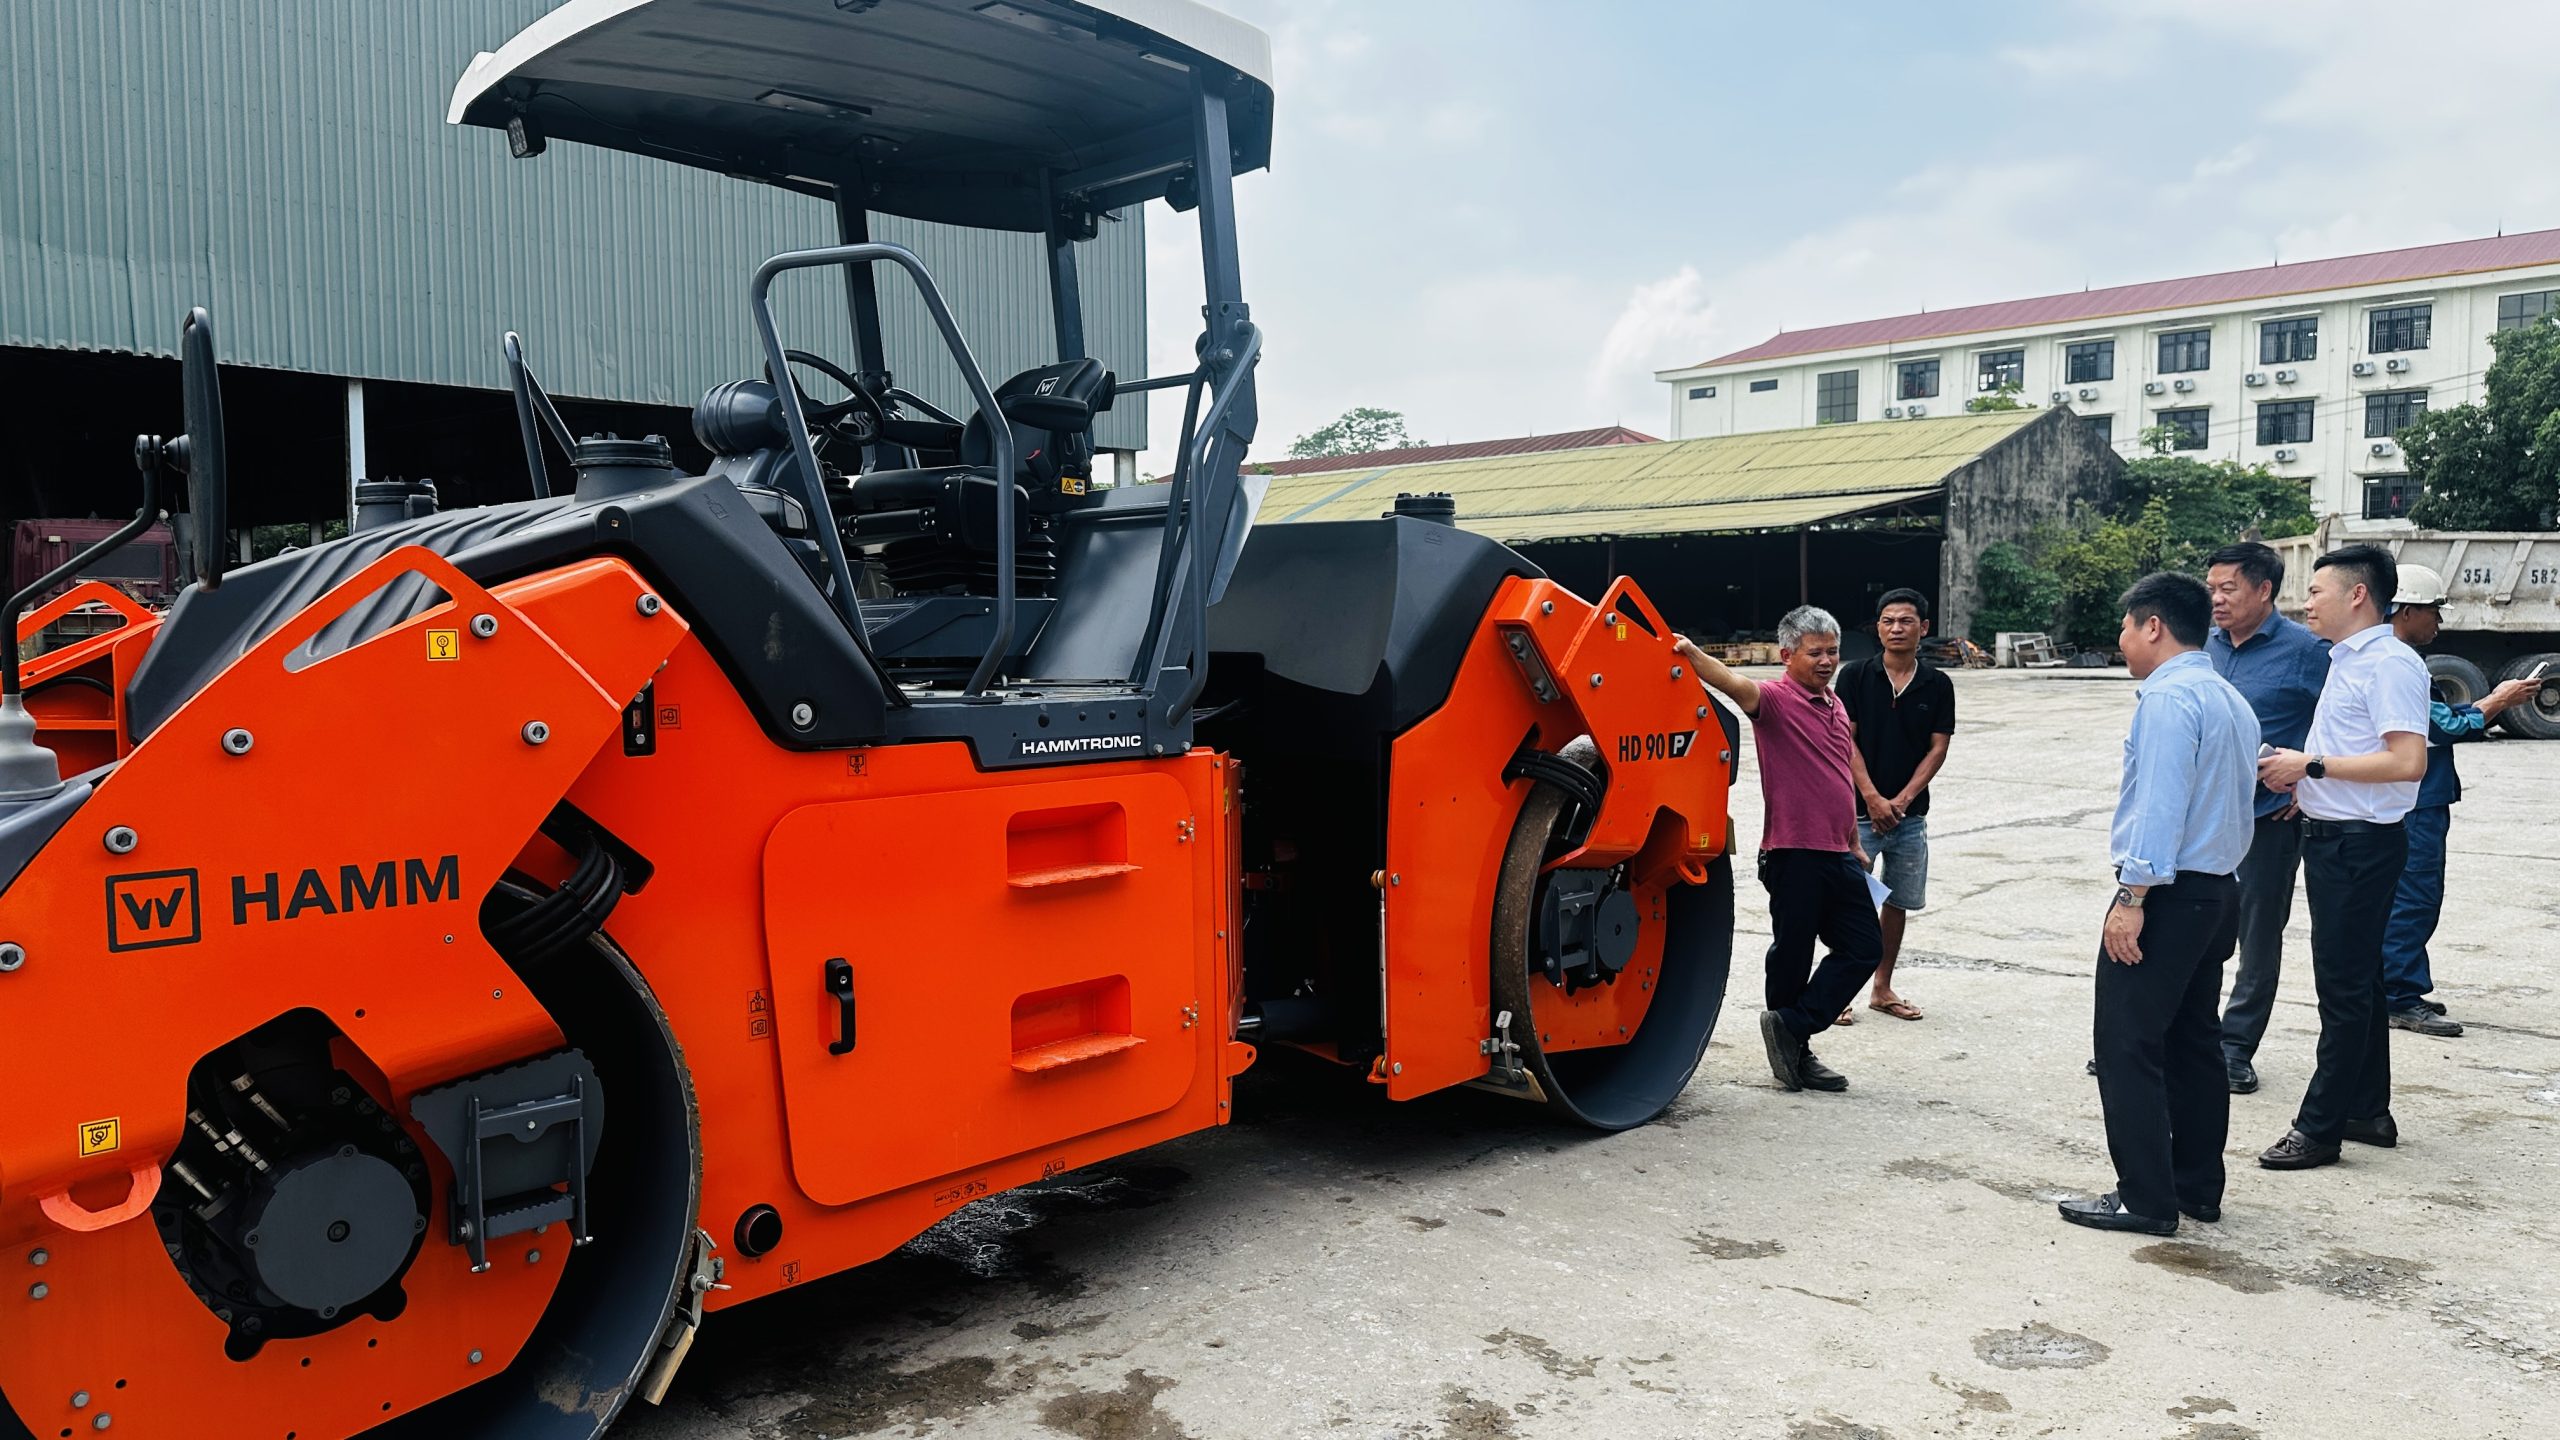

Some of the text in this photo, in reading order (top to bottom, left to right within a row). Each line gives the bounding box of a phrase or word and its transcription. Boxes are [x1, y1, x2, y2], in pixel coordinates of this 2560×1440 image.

[2464, 568, 2558, 584] 35A 582
[1022, 735, 1142, 755] HAMMTRONIC
[1619, 735, 1642, 762] HD
[1645, 733, 1665, 760] 90
[231, 854, 460, 925] HAMM
